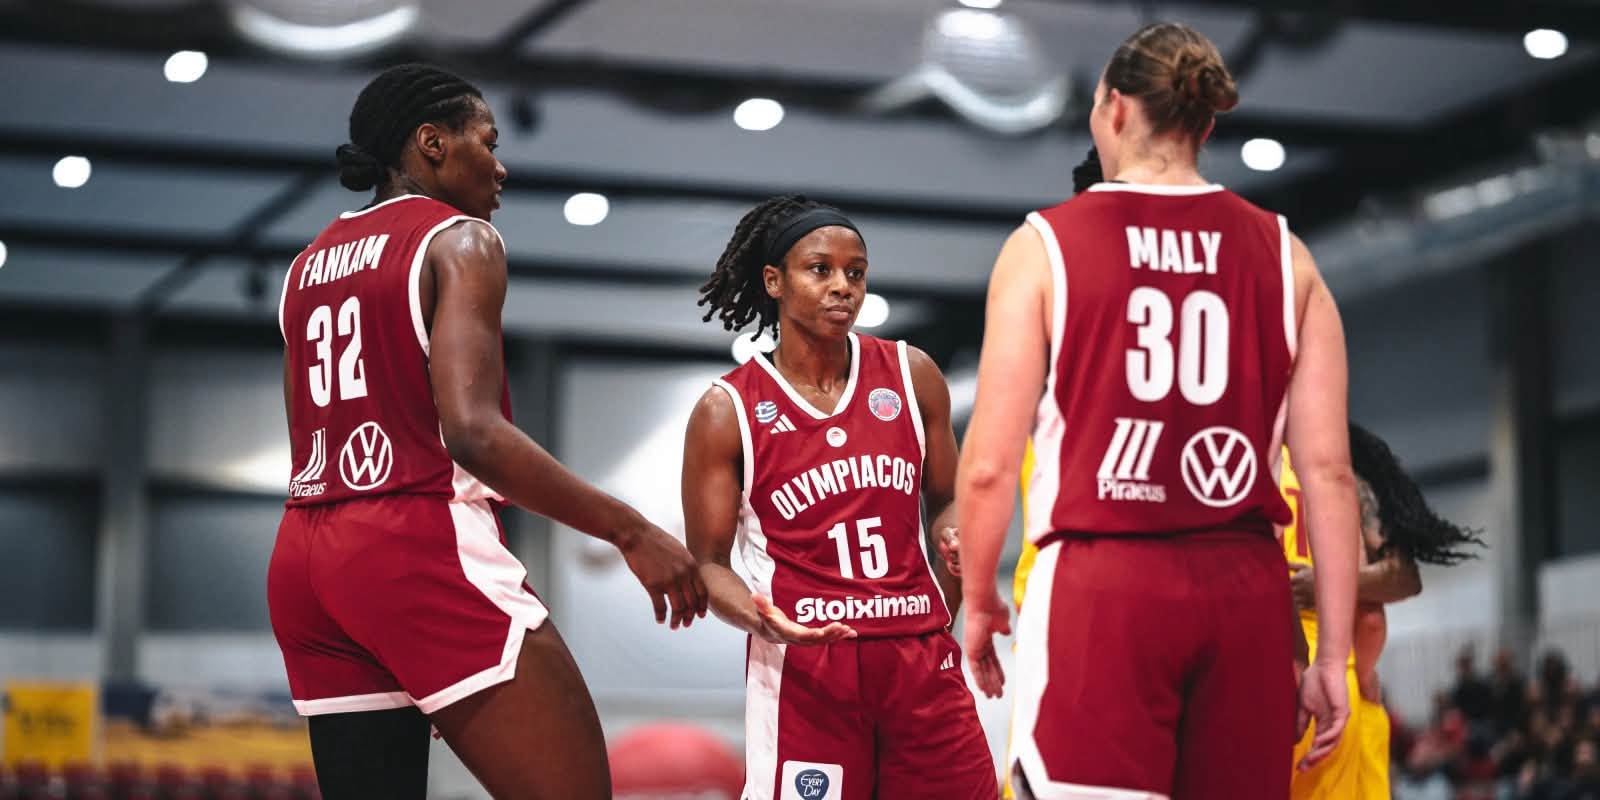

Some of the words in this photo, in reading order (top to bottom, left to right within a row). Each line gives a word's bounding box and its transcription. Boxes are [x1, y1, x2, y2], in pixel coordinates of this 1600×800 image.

[299, 234, 390, 290] FANKAM
[1125, 226, 1222, 275] MALY
[306, 296, 369, 408] 32
[1125, 286, 1230, 406] 30
[770, 454, 916, 521] OLYMPIACOS
[1098, 479, 1166, 502] Piraeus
[827, 516, 889, 579] 15
[795, 594, 931, 623] Stoiximan
